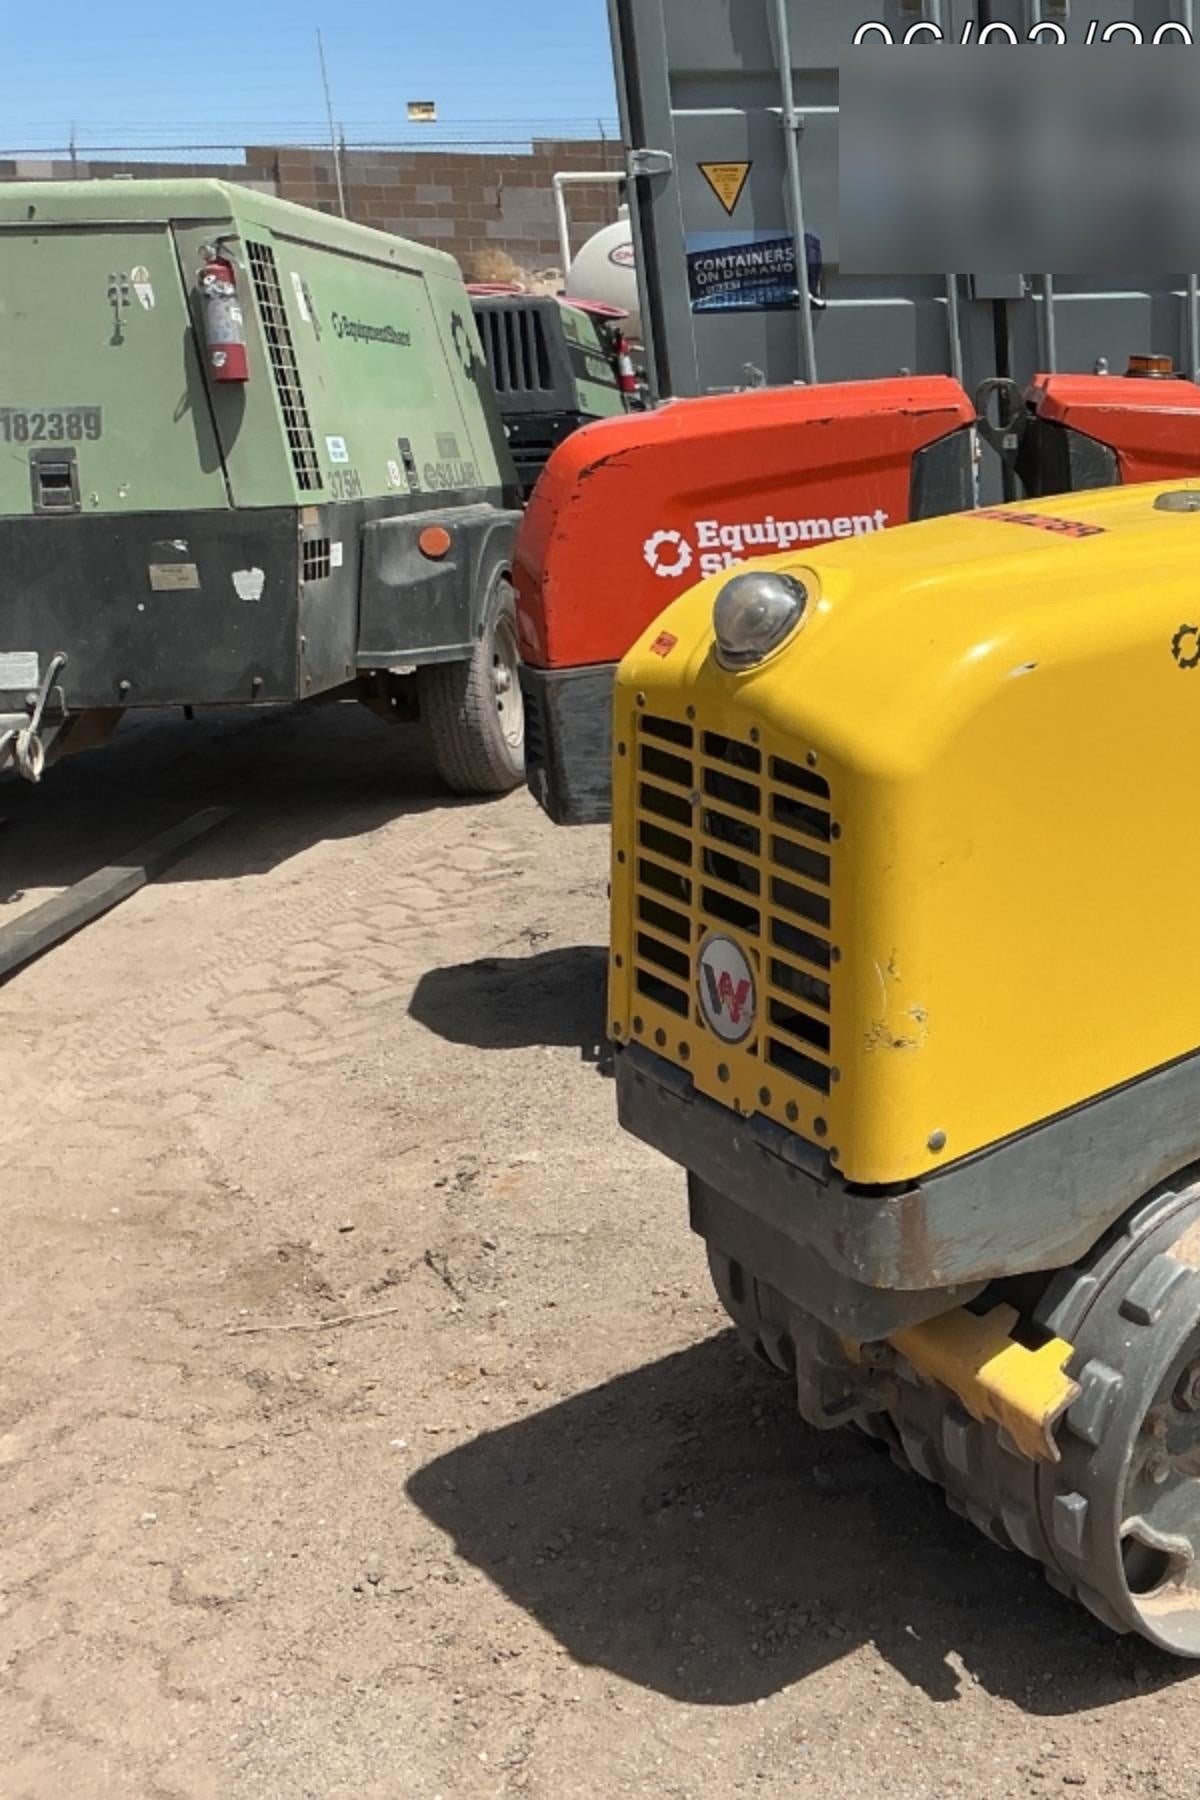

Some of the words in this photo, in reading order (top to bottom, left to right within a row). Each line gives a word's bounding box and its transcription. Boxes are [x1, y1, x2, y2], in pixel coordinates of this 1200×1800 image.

[693, 247, 795, 272] CONTAINERS
[696, 269, 720, 285] ON
[723, 262, 794, 280] DEMAND
[1, 411, 102, 443] 182389
[695, 509, 889, 551] Equipment
